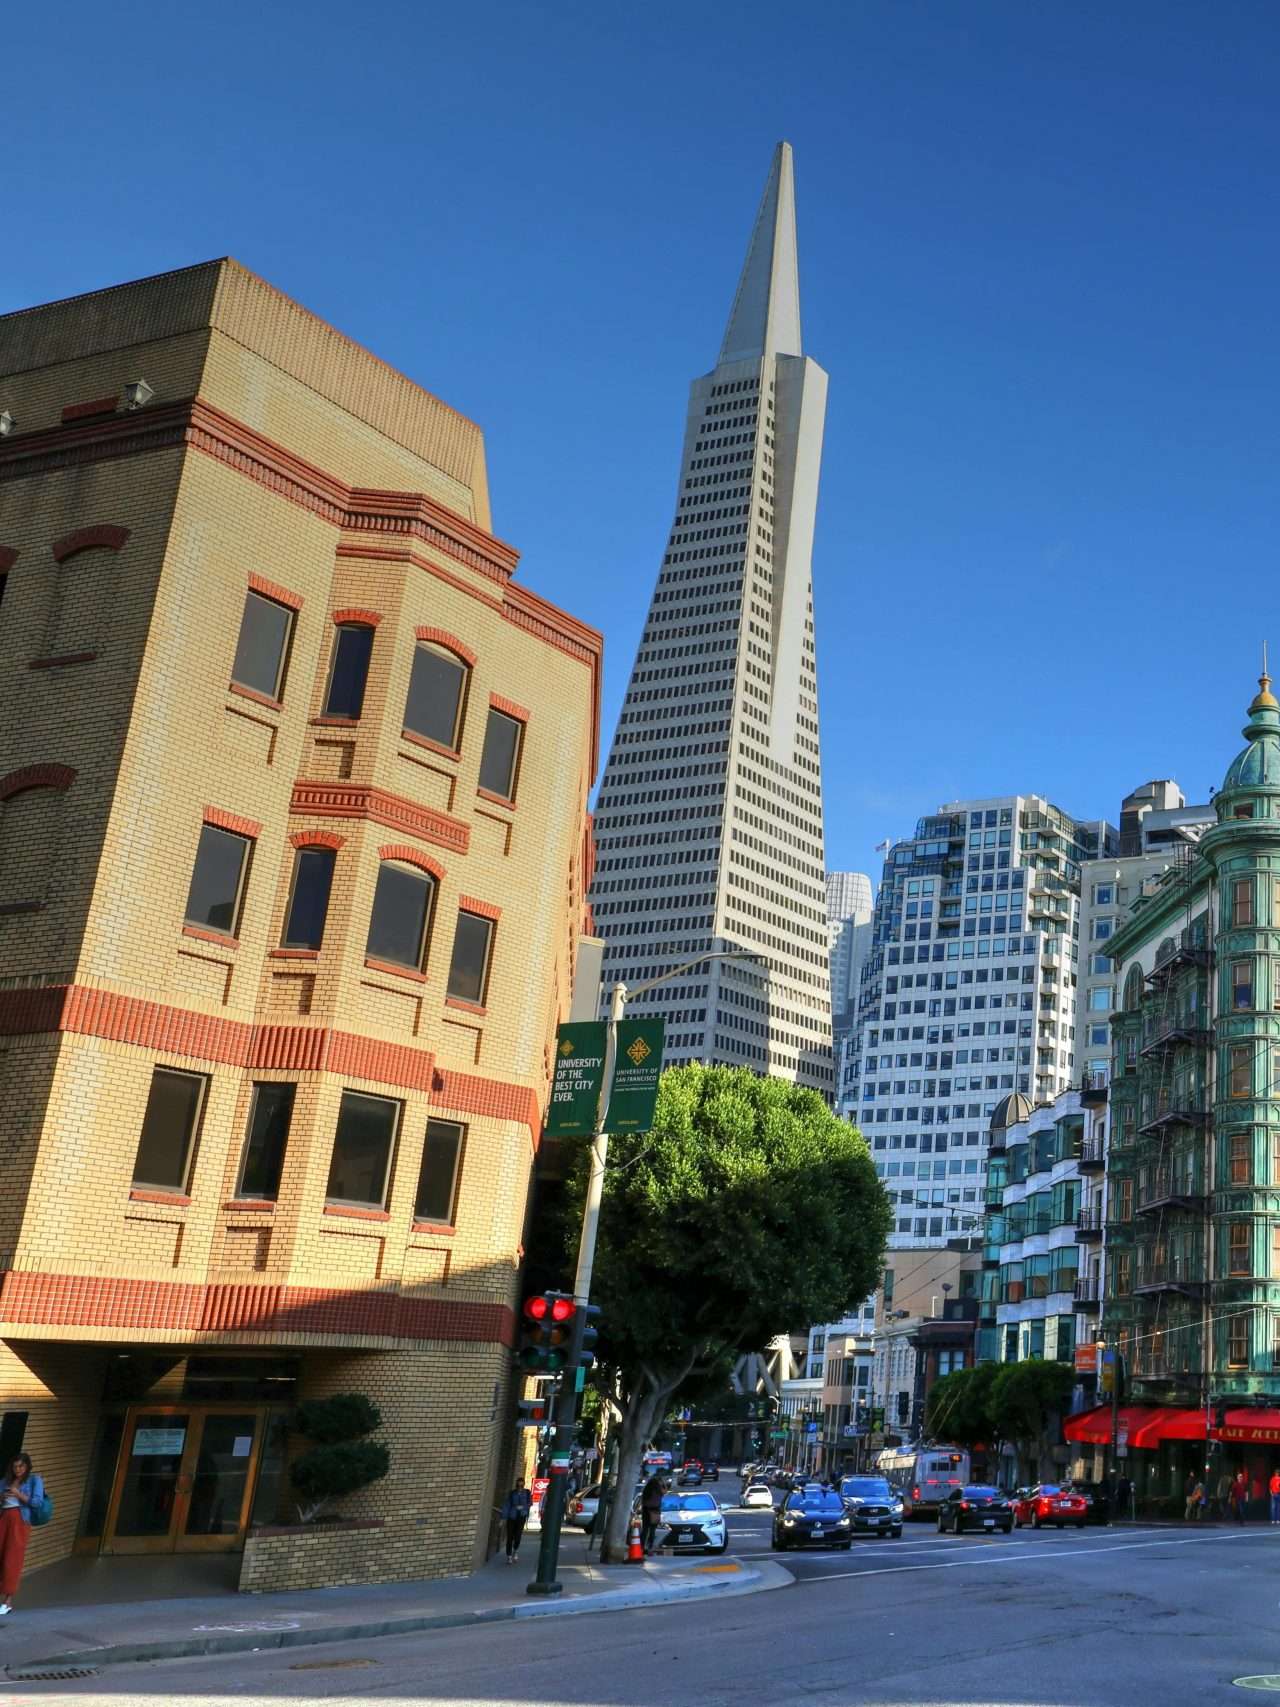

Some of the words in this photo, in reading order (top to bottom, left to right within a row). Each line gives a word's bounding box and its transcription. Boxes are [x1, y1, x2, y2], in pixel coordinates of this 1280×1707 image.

[558, 1058, 602, 1068] UNIVERSITY
[557, 1070, 568, 1079] OF
[568, 1069, 583, 1079] THE
[555, 1081, 573, 1090] BEST
[574, 1080, 594, 1090] CITY
[553, 1091, 574, 1102] EVER.
